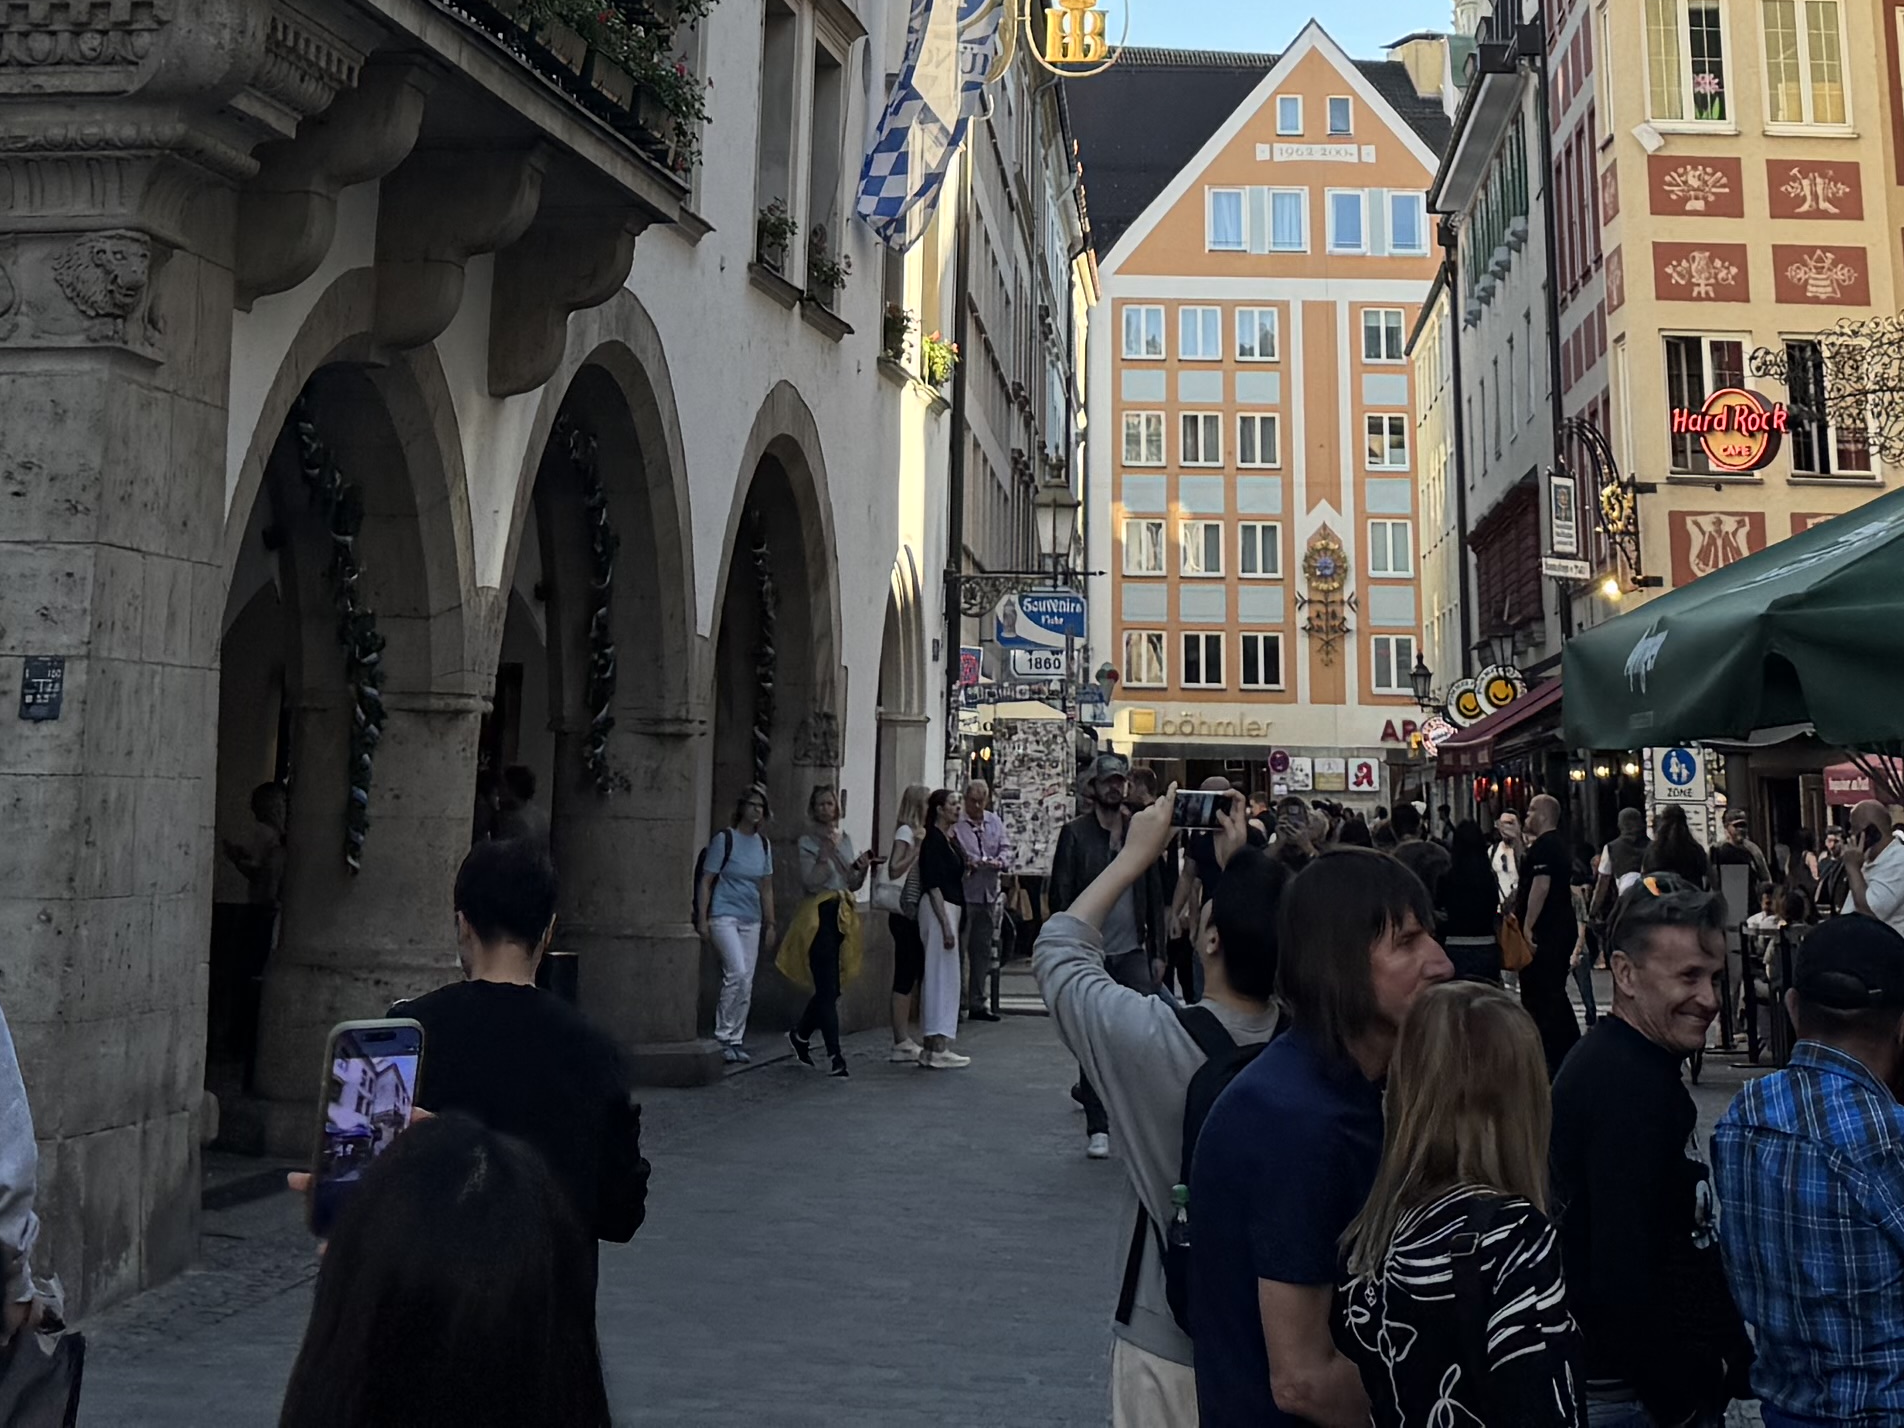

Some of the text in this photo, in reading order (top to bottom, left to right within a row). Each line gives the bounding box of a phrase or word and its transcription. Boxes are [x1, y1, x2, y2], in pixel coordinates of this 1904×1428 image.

[1044, 8, 1111, 63] HB
[1672, 401, 1790, 437] Hard Rock
[1027, 656, 1062, 671] 1860
[1161, 710, 1273, 737] böhmler
[1667, 787, 1694, 798] ZONE
